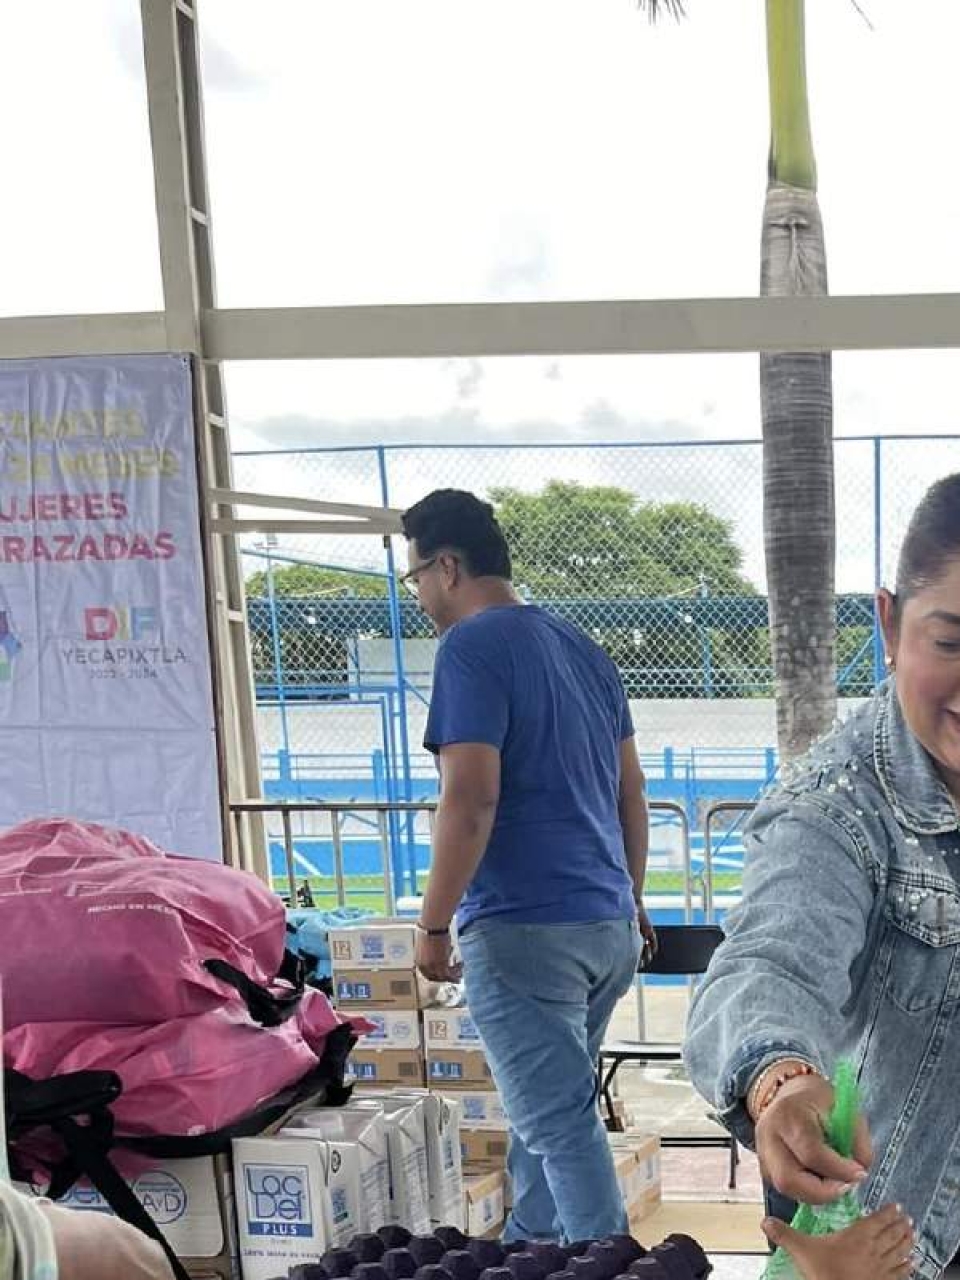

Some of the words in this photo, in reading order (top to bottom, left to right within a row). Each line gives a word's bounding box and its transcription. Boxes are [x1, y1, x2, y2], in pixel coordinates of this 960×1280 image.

[84, 606, 156, 641] DIF
[62, 648, 188, 665] YECAPIXTLA
[263, 1222, 297, 1234] PLUS
